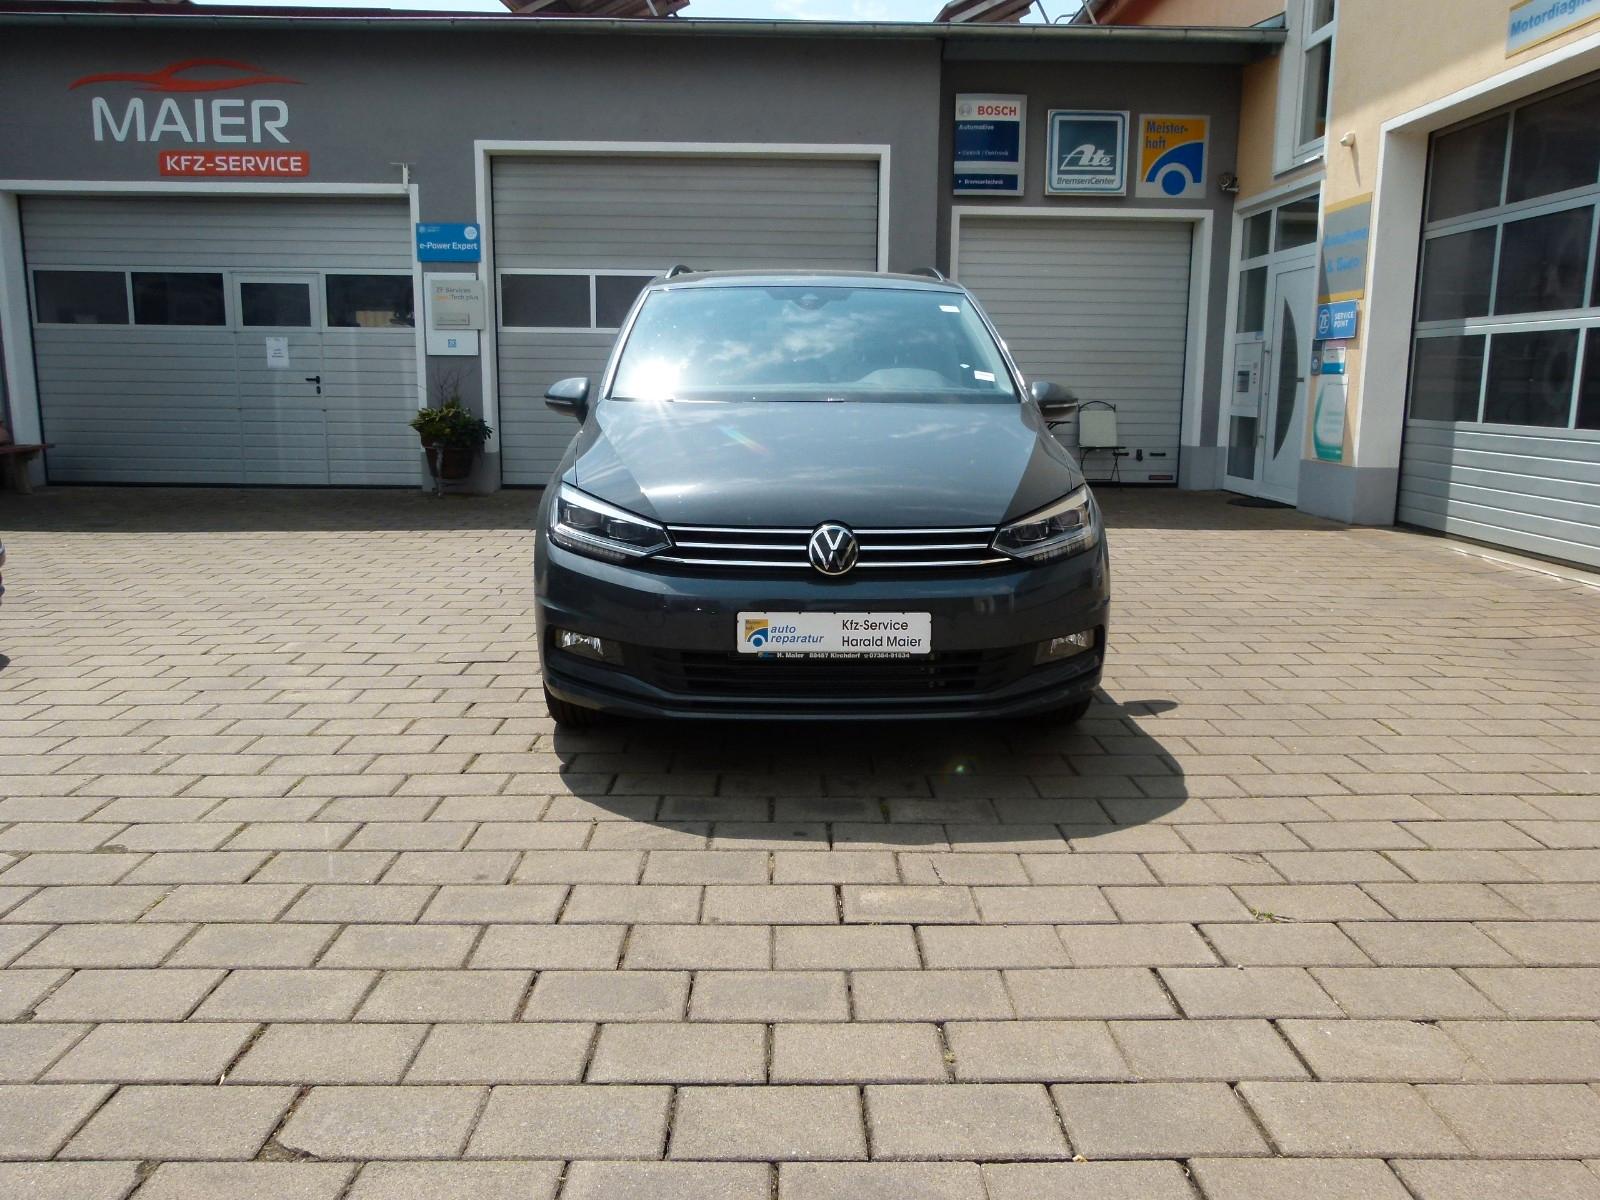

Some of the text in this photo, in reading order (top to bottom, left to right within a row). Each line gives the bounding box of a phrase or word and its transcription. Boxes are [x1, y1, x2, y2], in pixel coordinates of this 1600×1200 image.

[1510, 0, 1592, 36] Motordiagn
[977, 105, 1017, 116] BOSCH
[92, 97, 290, 143] MAIER
[1146, 120, 1188, 135] Meister-
[1145, 135, 1167, 150] haft
[1060, 143, 1114, 171] Ate
[166, 155, 302, 172] KFZ-SERVICE
[1056, 176, 1116, 186] BremsenCenter
[419, 241, 478, 251] e-Power Expert
[1334, 310, 1355, 321] SERVICE
[1333, 319, 1349, 329] POINT
[770, 625, 796, 634] auto
[842, 619, 909, 631] Kfz-Service
[770, 634, 825, 646] reparatur
[842, 635, 922, 647] Harald Maier
